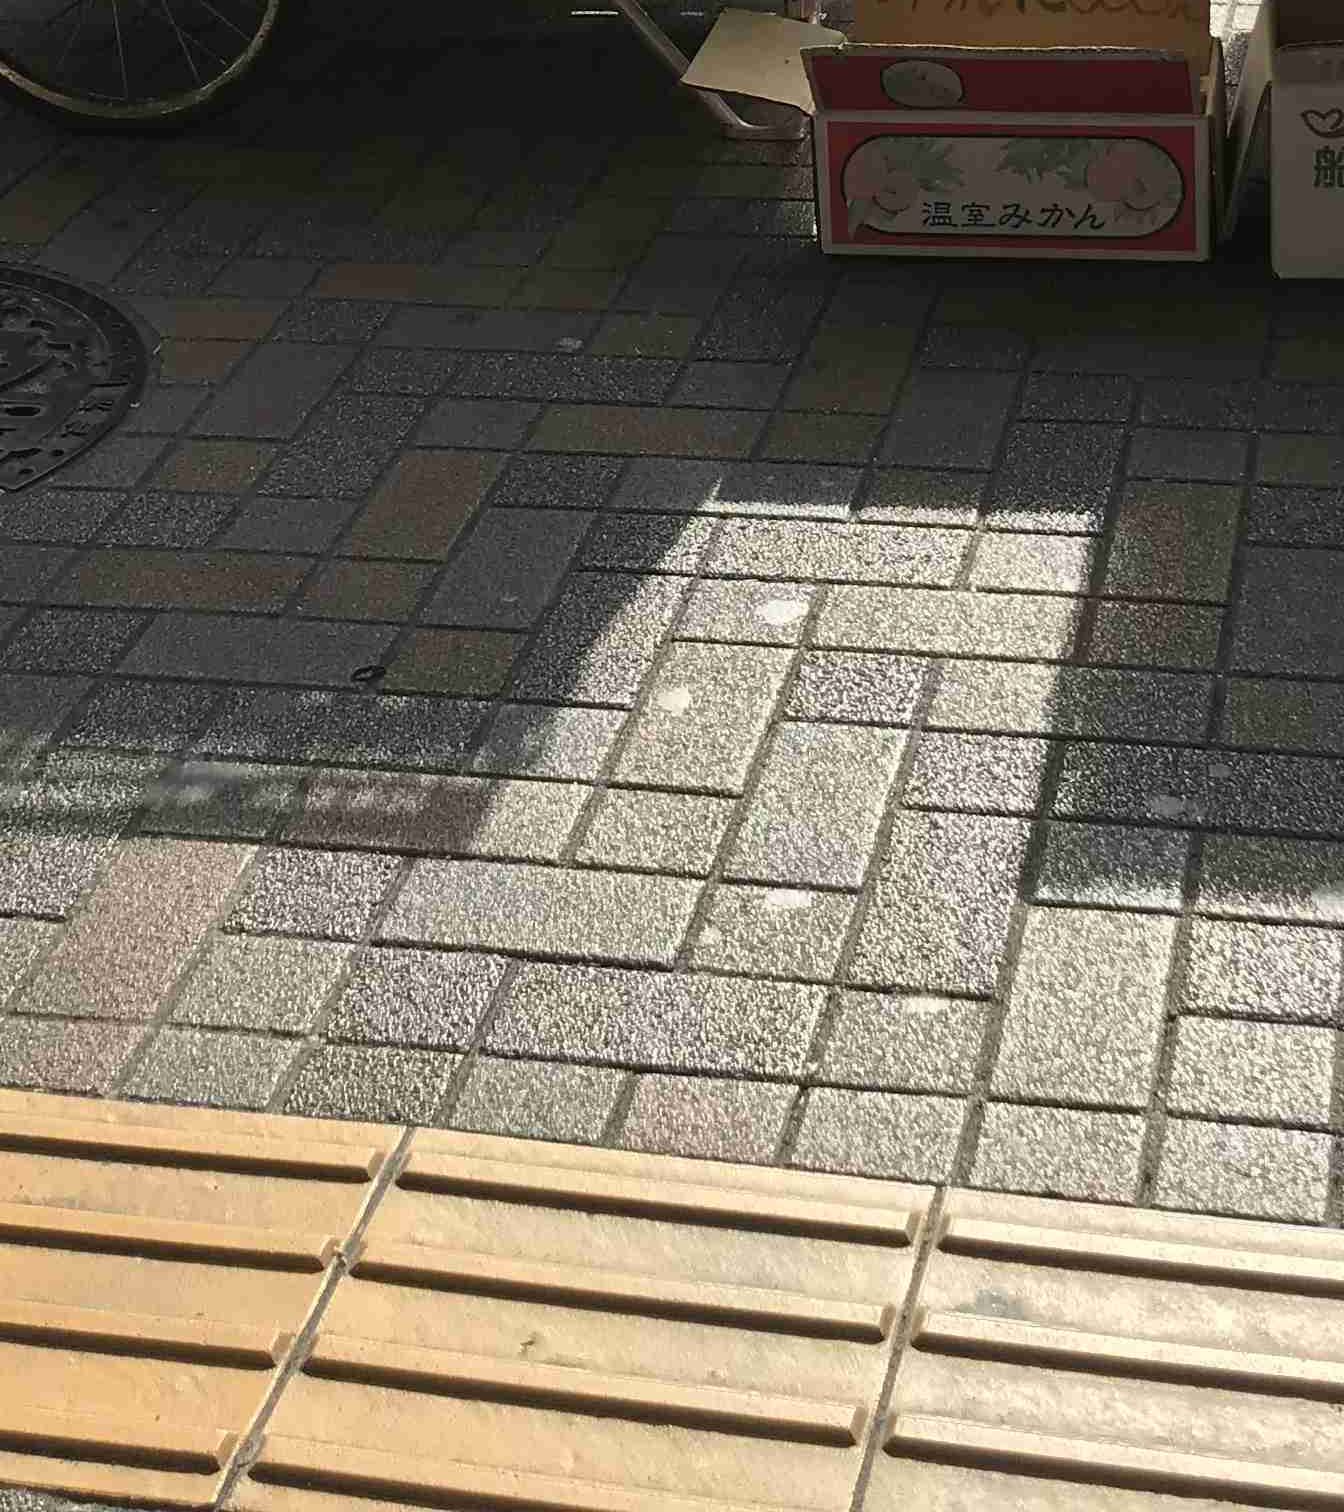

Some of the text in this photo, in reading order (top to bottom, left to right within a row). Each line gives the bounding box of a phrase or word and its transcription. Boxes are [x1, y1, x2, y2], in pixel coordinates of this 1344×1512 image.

[922, 201, 1106, 231] 温室みかん
